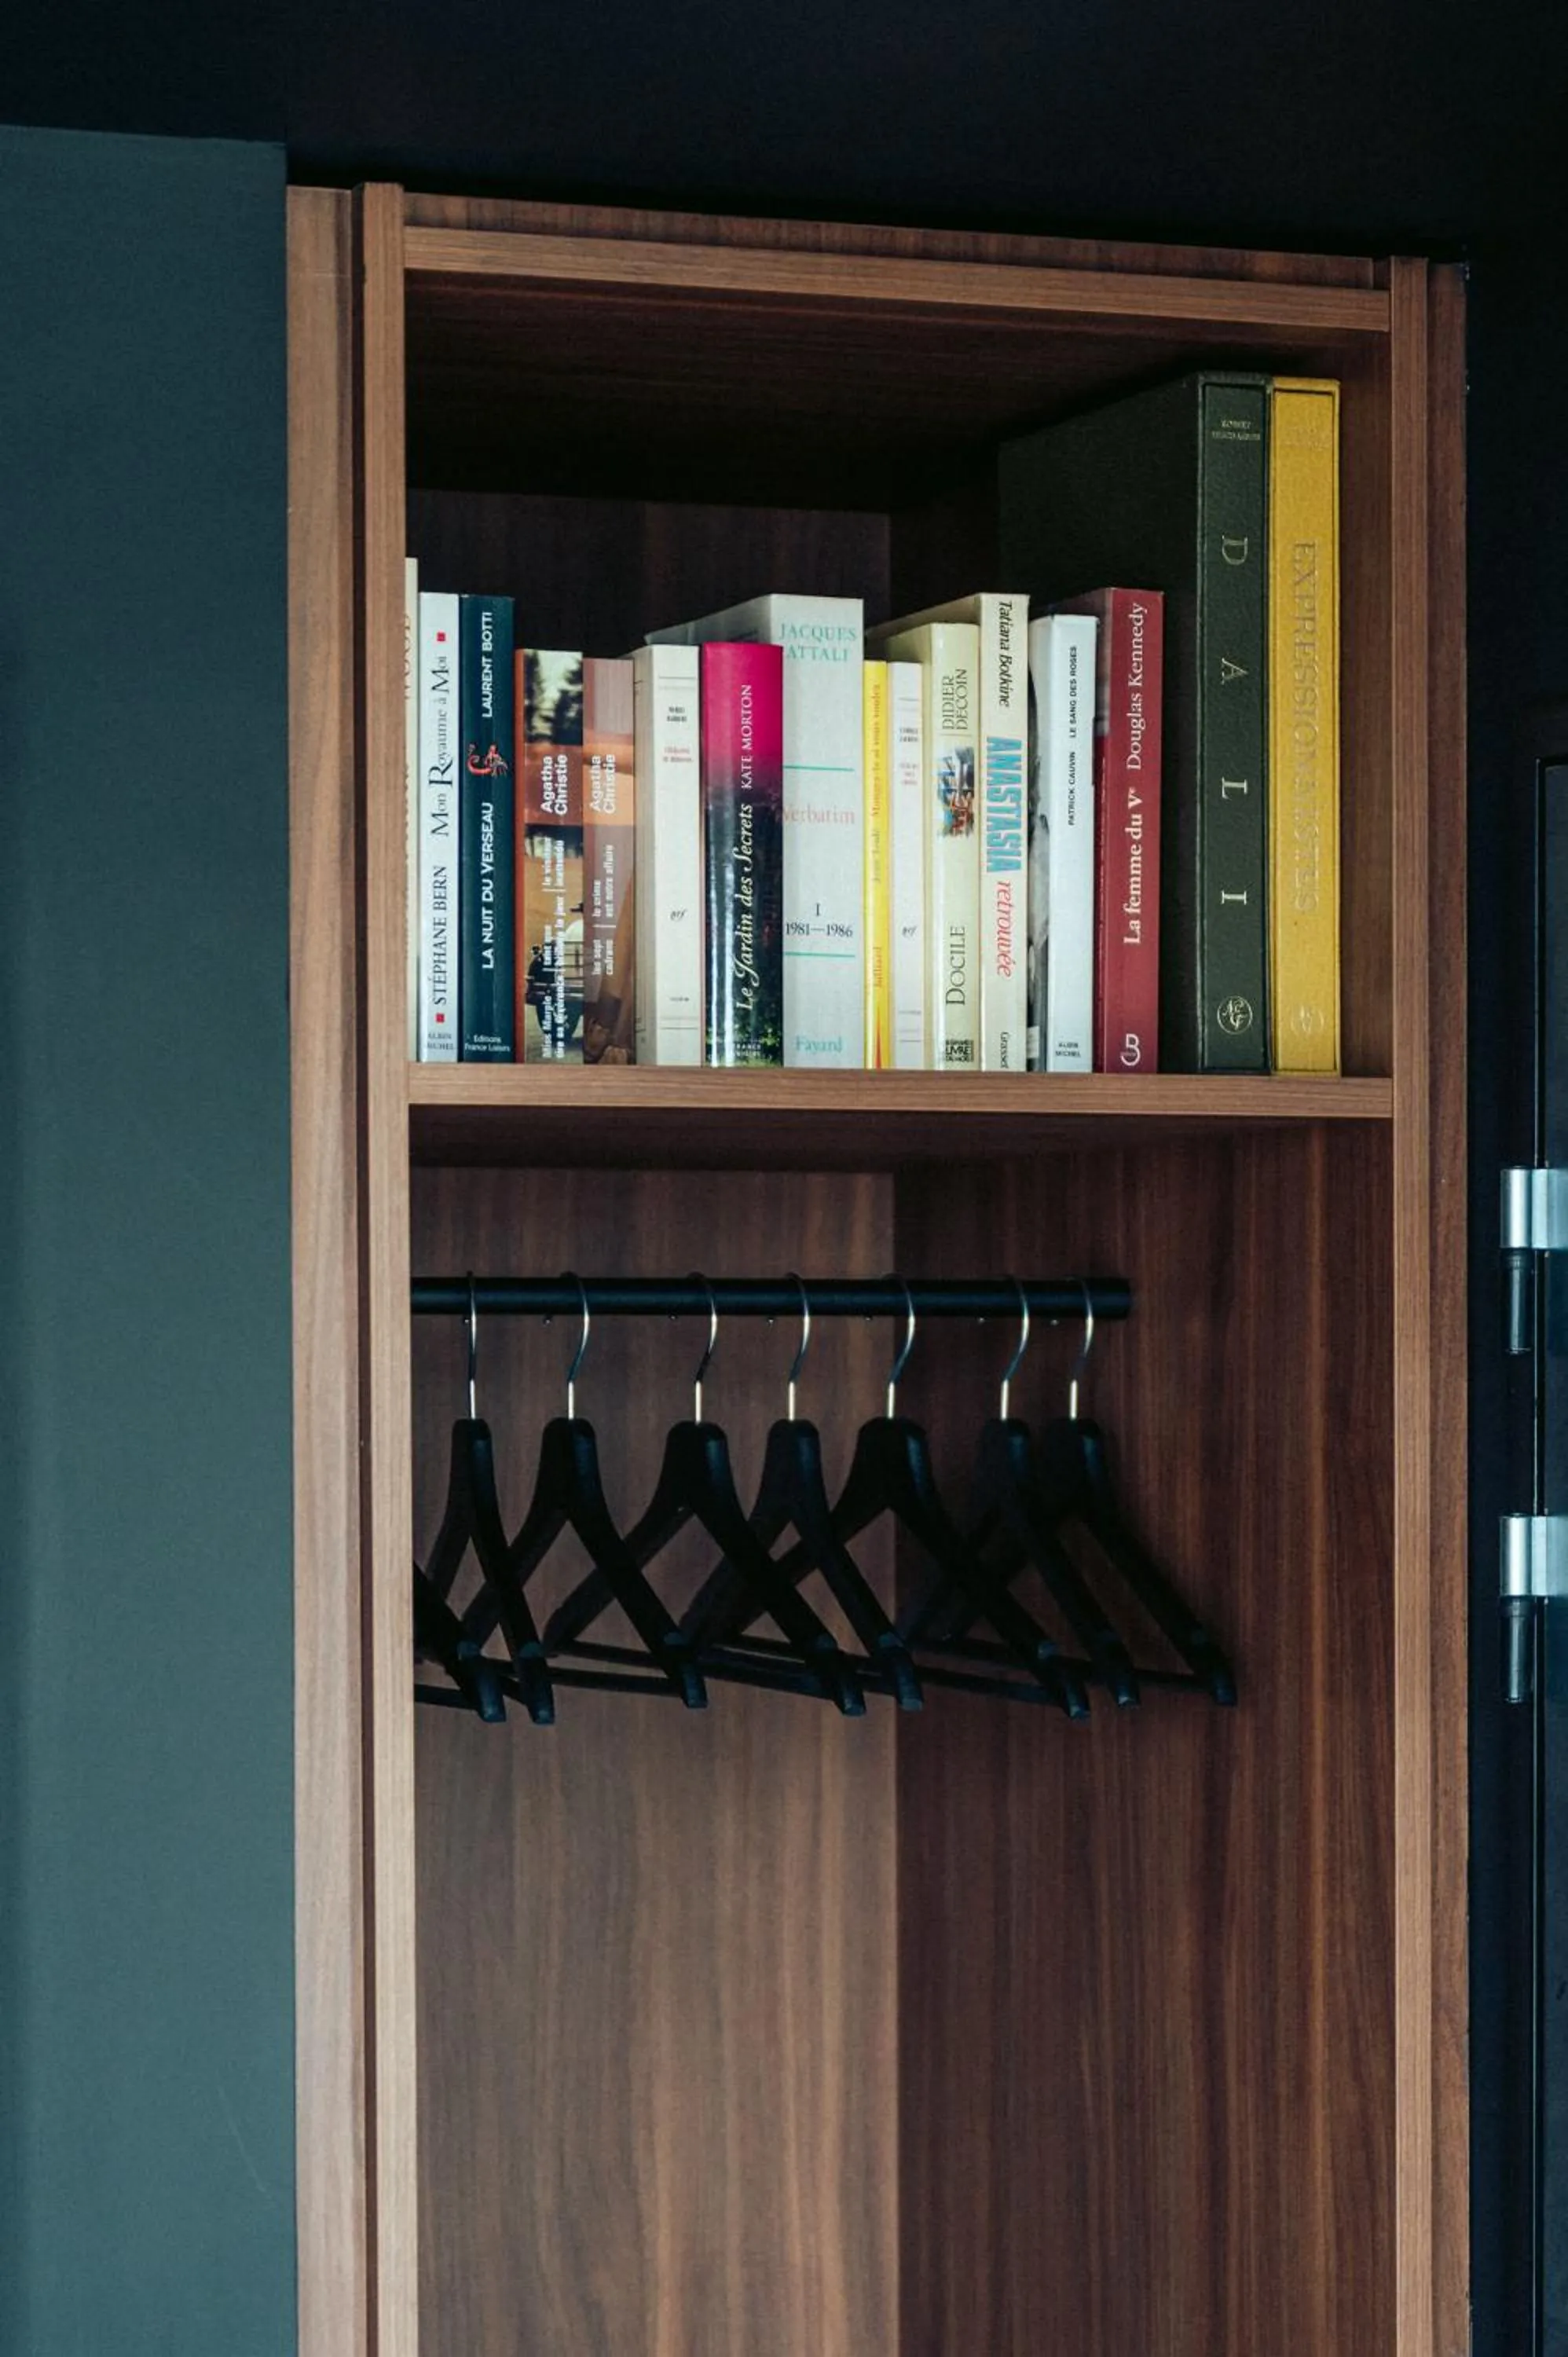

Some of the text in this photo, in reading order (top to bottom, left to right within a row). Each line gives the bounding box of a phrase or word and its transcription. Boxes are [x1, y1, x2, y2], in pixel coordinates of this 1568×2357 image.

[779, 622, 858, 643] JACQUES
[786, 644, 849, 662] ATTALI
[998, 599, 1013, 708] Tatiana Botkine
[1069, 646, 1078, 676] ROSES
[431, 655, 450, 695] Moi
[482, 611, 493, 718] LAURENT BOTTI
[1126, 603, 1148, 771] Douglas Kennedy
[942, 674, 956, 730] DIDIER
[956, 668, 968, 731] DECOIN
[428, 708, 453, 787] Royaume
[741, 684, 753, 790] KATE MORTON
[1069, 728, 1077, 739] LE
[540, 755, 553, 813] Agatha
[554, 753, 569, 815] Christie
[589, 755, 602, 813] Agatha
[602, 753, 616, 814] Christie
[986, 736, 1023, 873] ANASTASIA
[1068, 751, 1076, 827] PATRICK CAUVIN
[431, 792, 450, 838] Mon
[1125, 812, 1143, 839] du
[480, 801, 495, 970] LA NUIT DU VERSEAU
[733, 803, 760, 1011] Le Jardin des Secrets
[1124, 843, 1142, 915] femme
[429, 865, 447, 1006] STÉPHANE BERN
[815, 903, 821, 917] I
[996, 879, 1017, 978] retrouvée
[1123, 918, 1141, 944] La
[796, 1035, 843, 1055] Fayard
